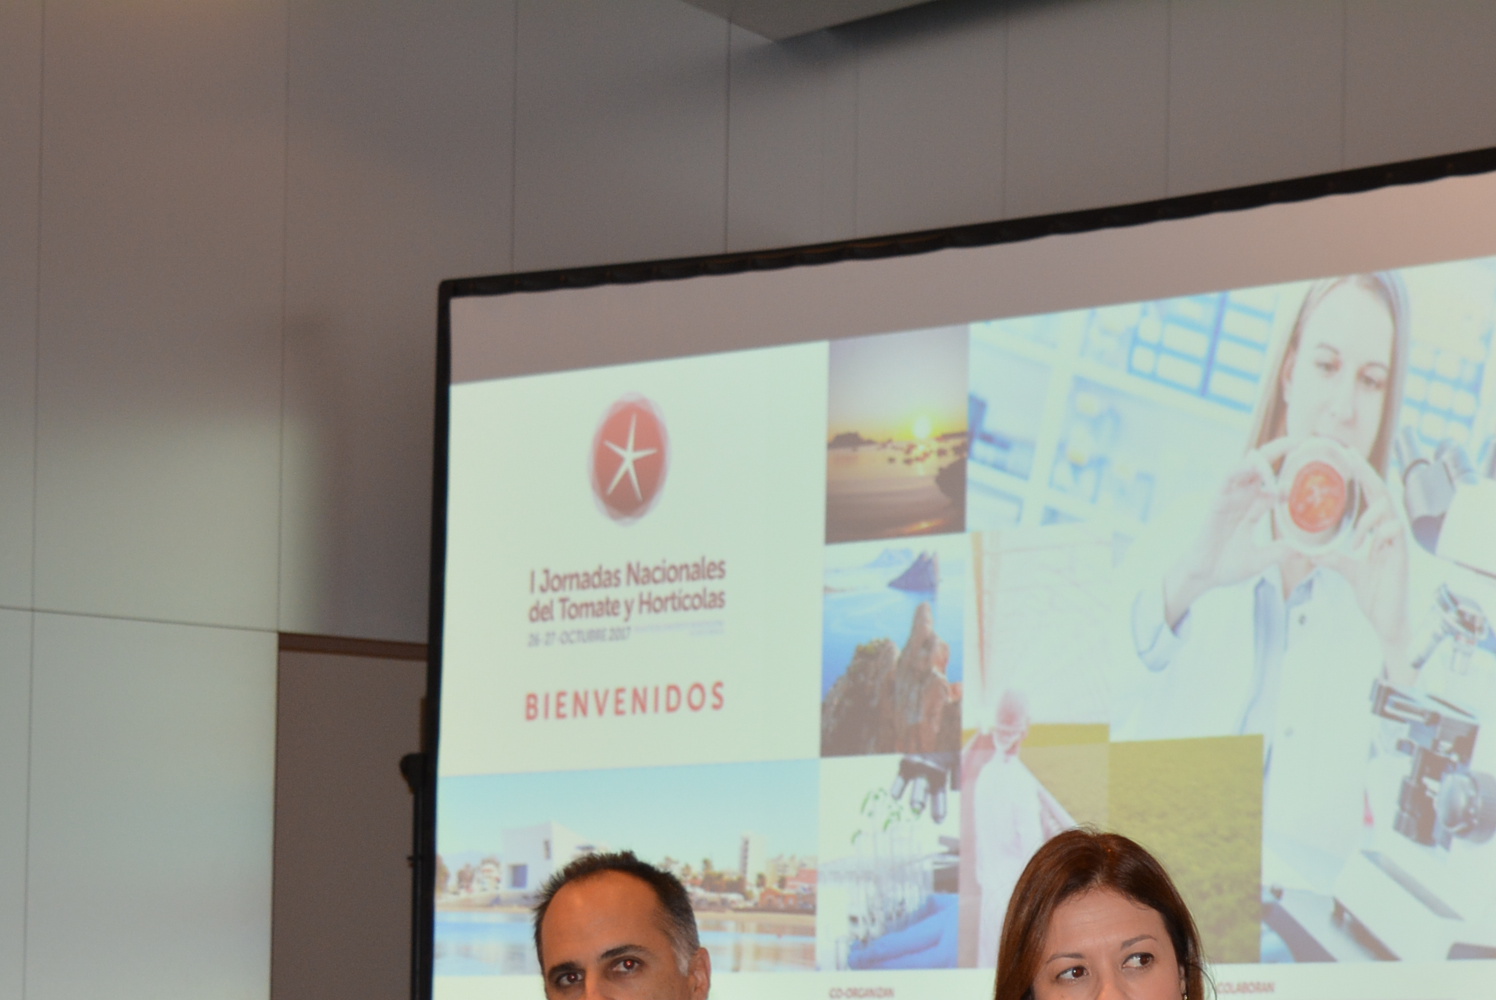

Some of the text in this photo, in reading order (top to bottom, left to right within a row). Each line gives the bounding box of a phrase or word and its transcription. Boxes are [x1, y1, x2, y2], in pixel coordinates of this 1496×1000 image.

[530, 556, 726, 594] I Jornadas Nacionales
[529, 601, 554, 623] del
[559, 597, 620, 621] Tomate
[624, 598, 634, 623] y
[609, 626, 632, 642] 2017
[525, 681, 725, 721] BIENVENIDOS
[829, 987, 895, 999] CO-ORGANIZAN
